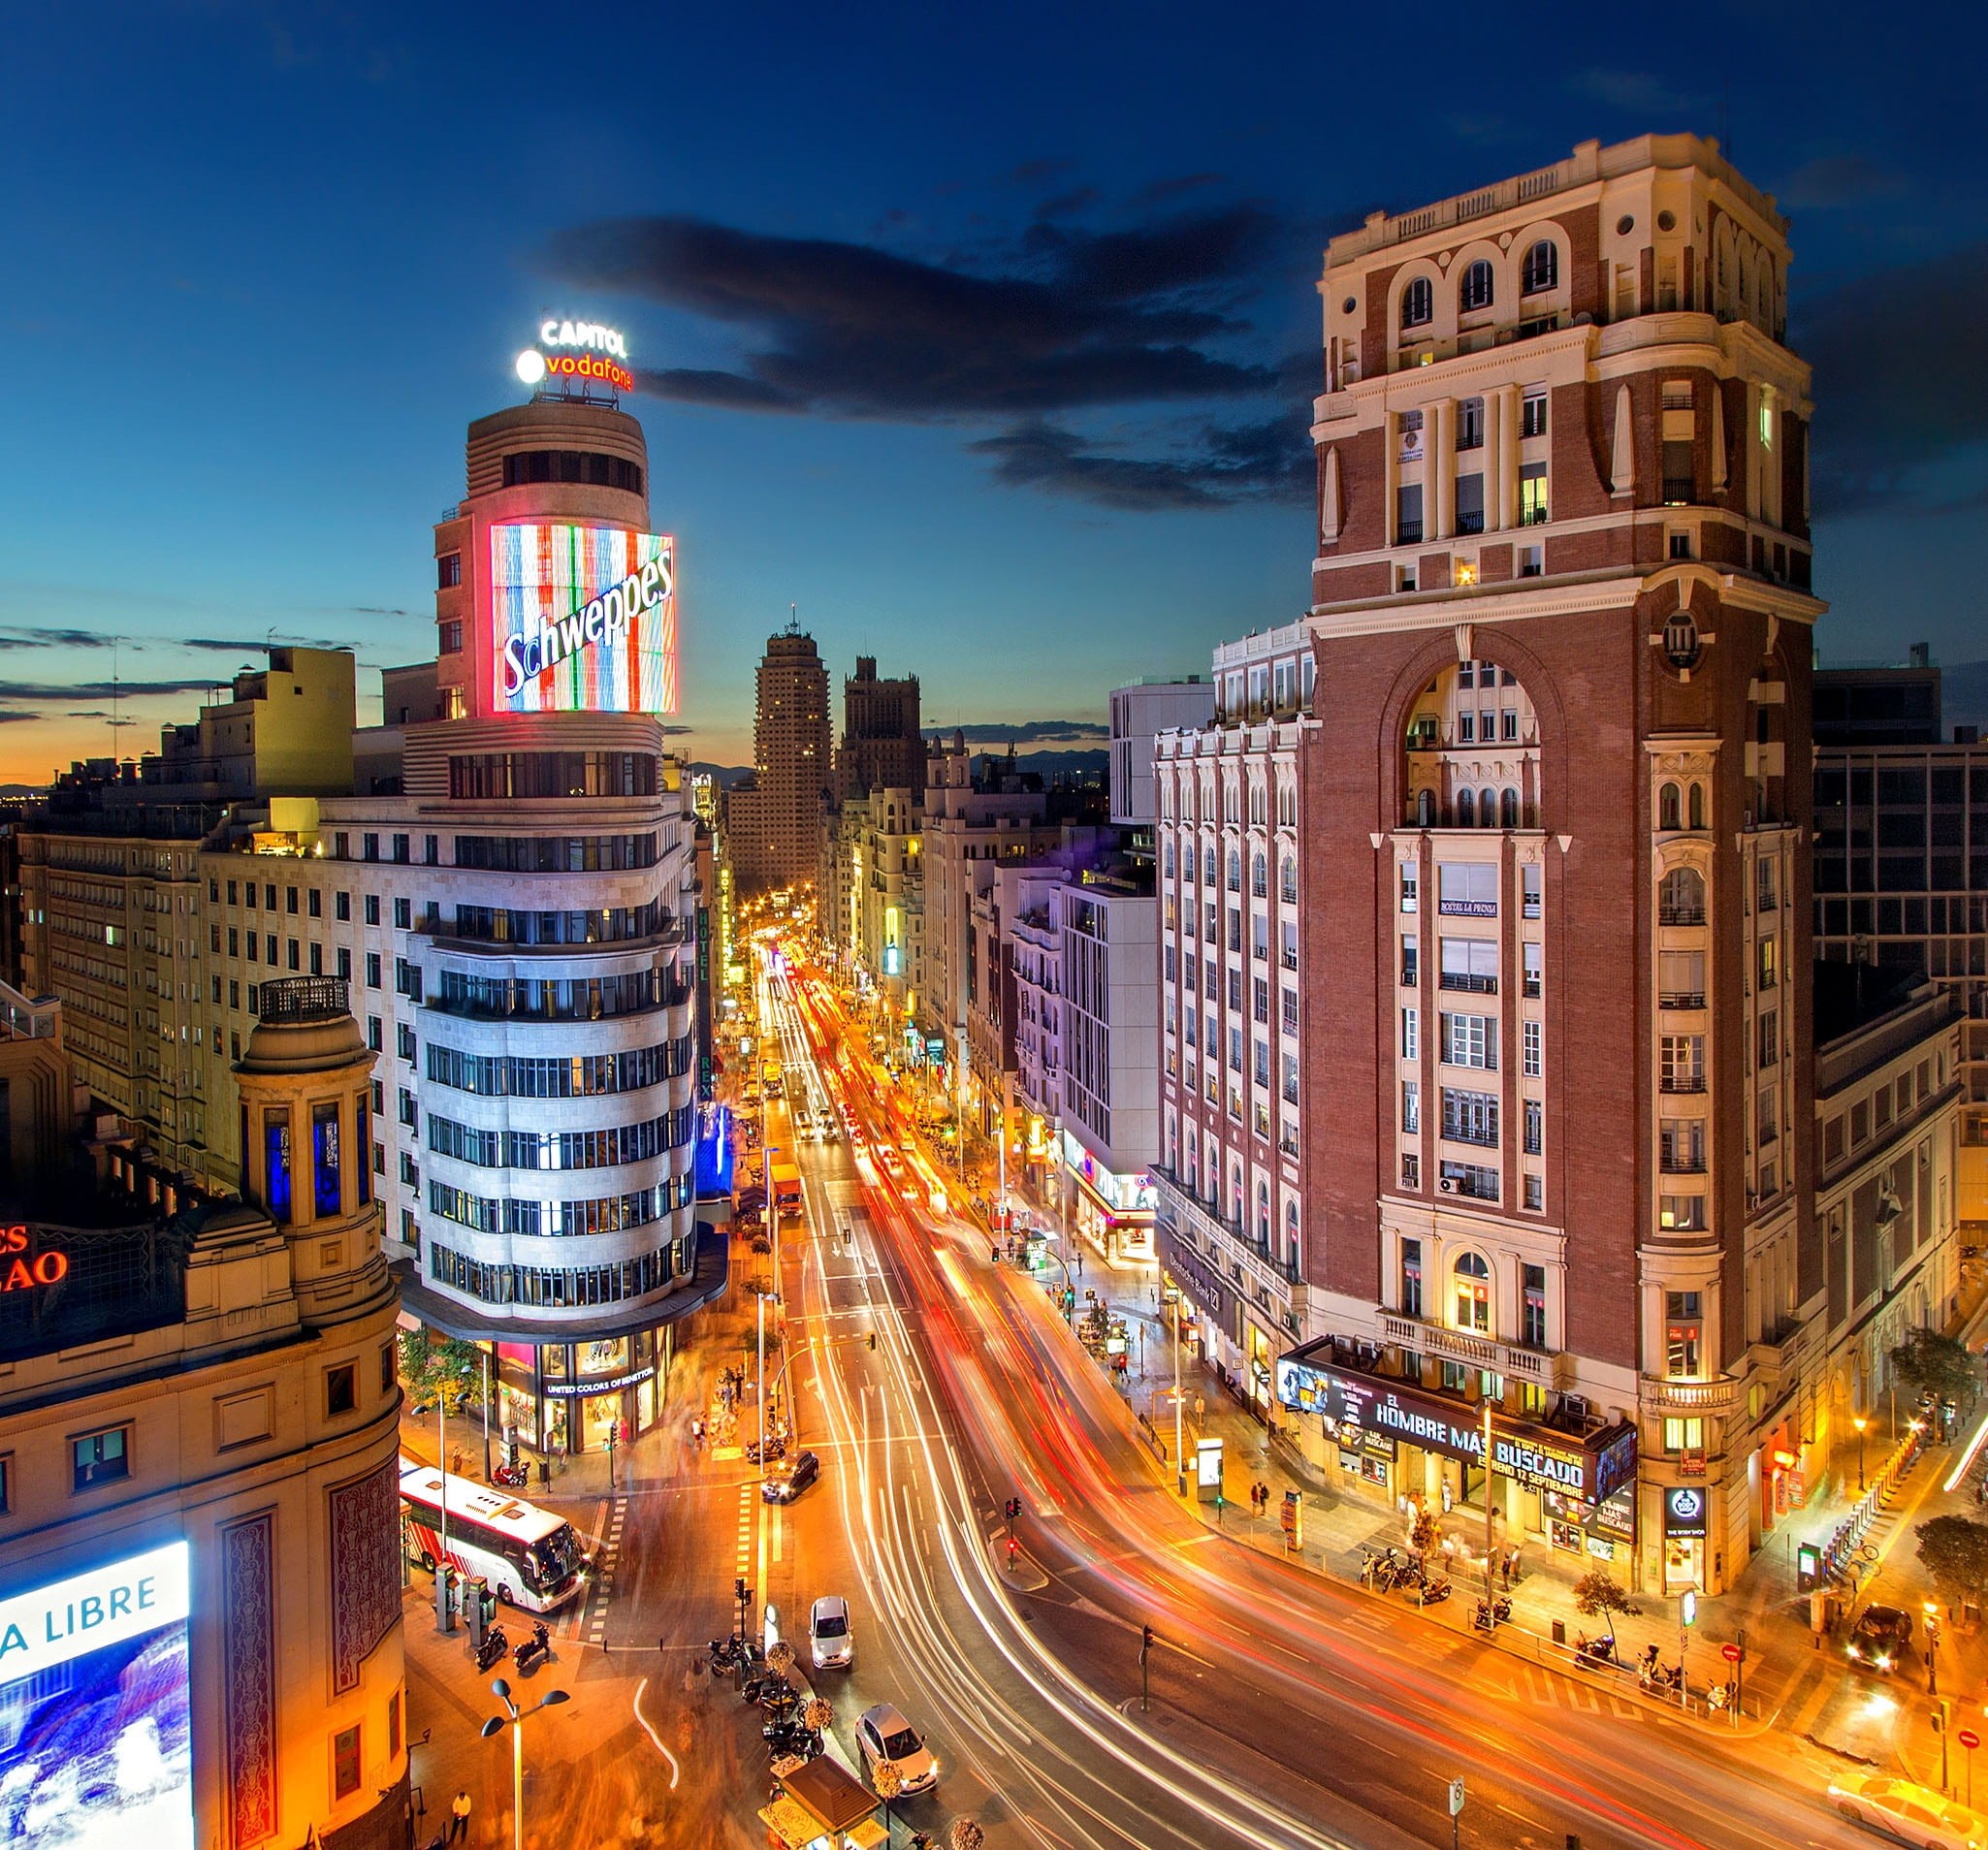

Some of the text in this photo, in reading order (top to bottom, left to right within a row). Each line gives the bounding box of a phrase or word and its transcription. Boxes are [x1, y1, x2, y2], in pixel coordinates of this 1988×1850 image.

[542, 321, 626, 359] CAPITOL
[546, 355, 633, 392] vodafone
[505, 549, 671, 697] Schweppes
[1441, 902, 1496, 913] HOSTAL LA PRENSA
[699, 913, 710, 1097] HOTEL REX
[1170, 1252, 1210, 1303] Deutsche Bank
[547, 1366, 655, 1394] UNITED COLORS OF BENETTON
[1387, 1393, 1398, 1408] EL
[1375, 1403, 1447, 1443] HOMBRE
[1495, 1441, 1584, 1487] BUSCADO
[1477, 1455, 1584, 1499] ESRENO 12 SEPTIEMBRE
[46, 1576, 155, 1643] LIBRE
